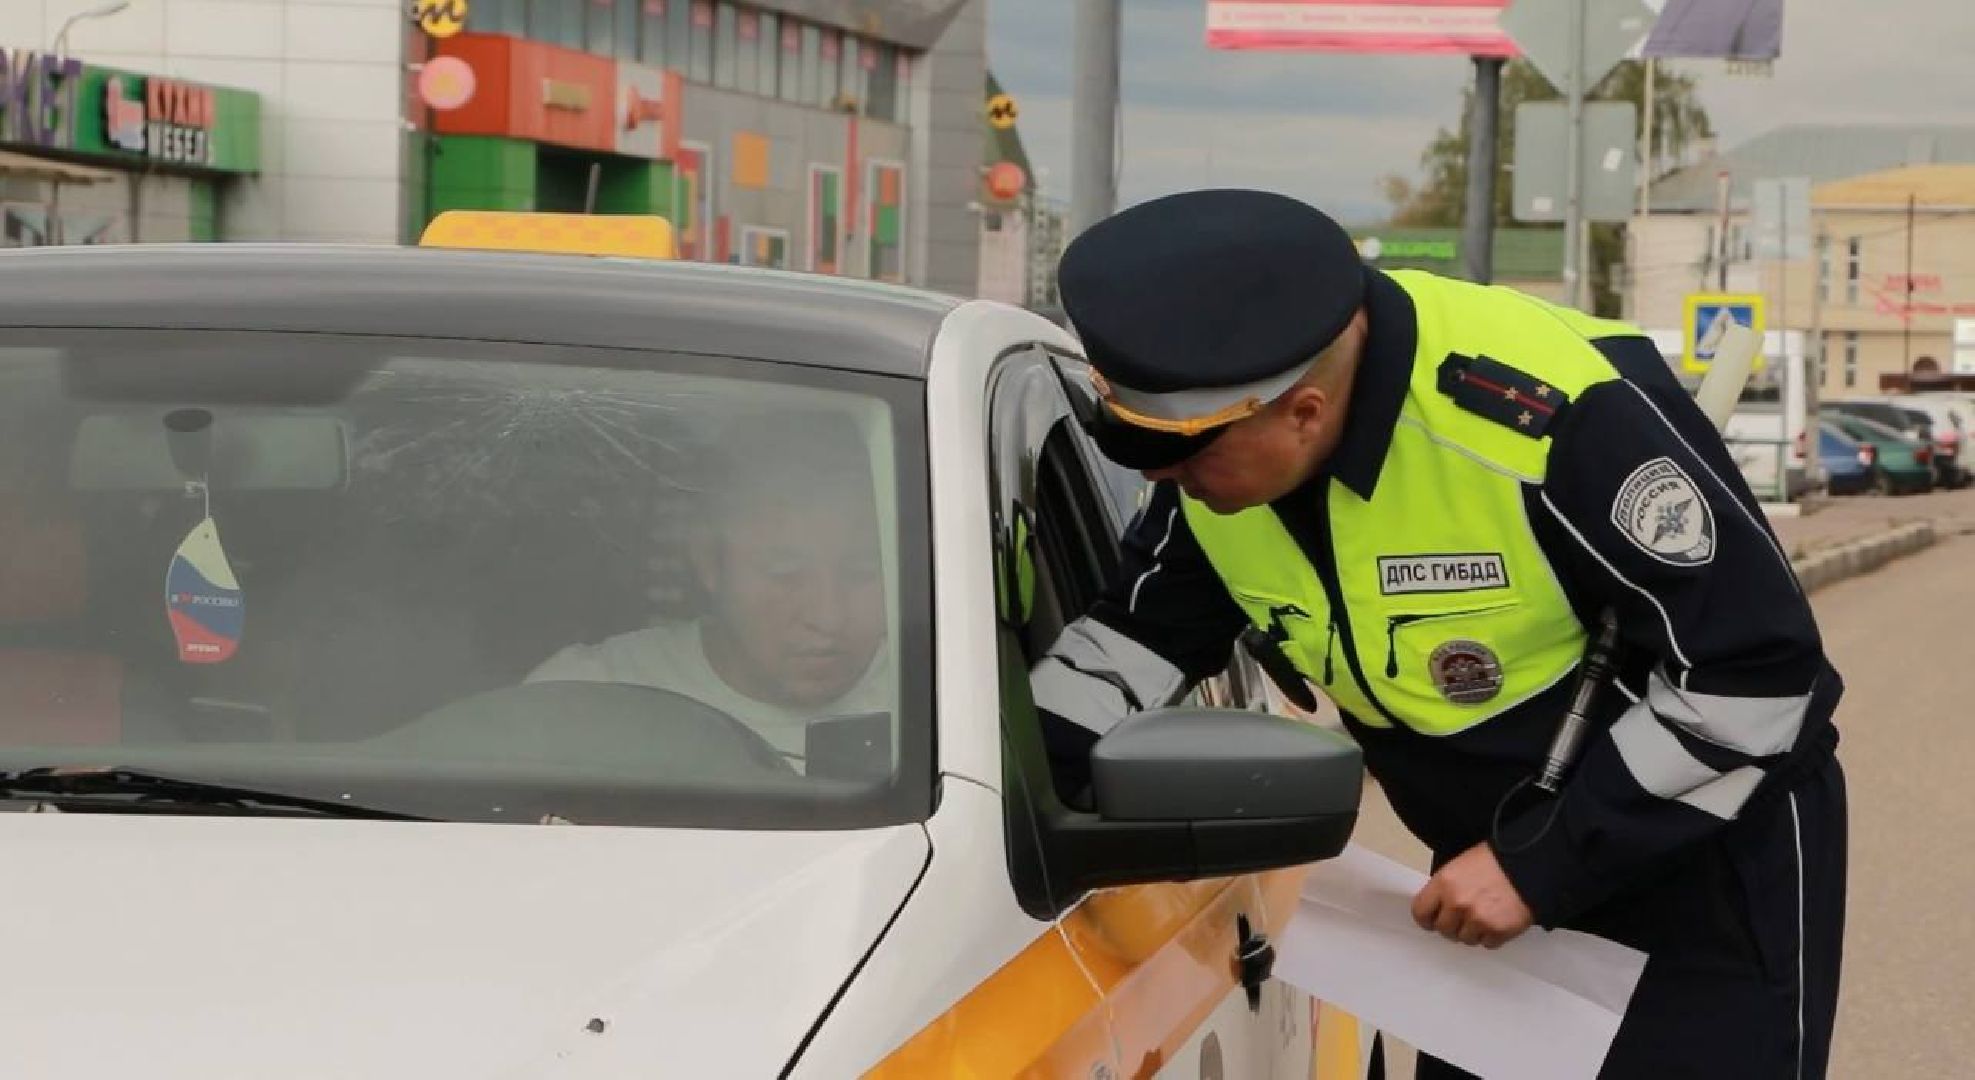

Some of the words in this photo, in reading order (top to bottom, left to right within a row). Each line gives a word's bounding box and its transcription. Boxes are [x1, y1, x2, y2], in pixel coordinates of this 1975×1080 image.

[147, 76, 216, 130] КУХНИ
[148, 121, 216, 165] МЕБЕЛЬ
[1618, 463, 1675, 525] ПОЛИЦИЯ
[1636, 481, 1681, 533] РОССИЯ
[1386, 563, 1427, 587] ДПС
[1431, 560, 1500, 584] ГИБДД
